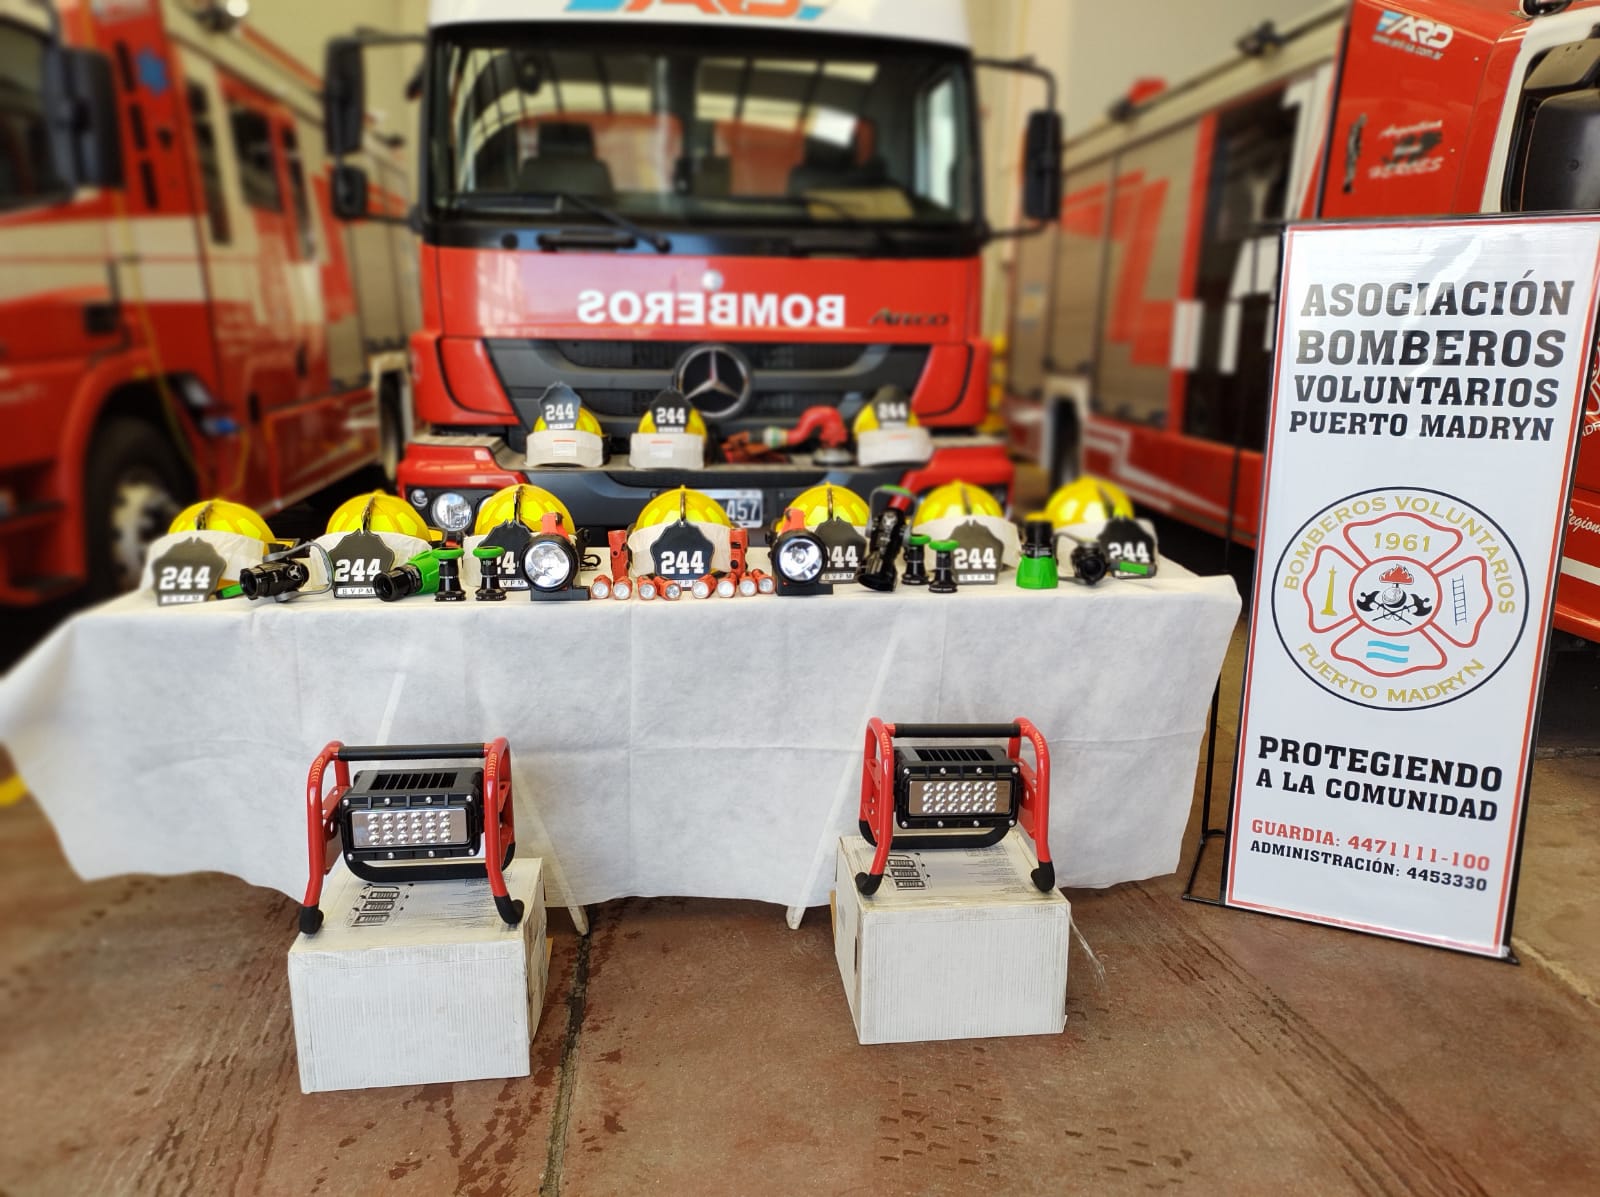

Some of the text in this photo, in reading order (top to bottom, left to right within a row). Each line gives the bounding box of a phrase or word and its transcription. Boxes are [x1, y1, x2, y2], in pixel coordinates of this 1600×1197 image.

[1300, 269, 1575, 317] ASOCIACIÓN
[1295, 329, 1566, 368] BOMBEROS
[1294, 374, 1559, 408] VOLUNTARIOS
[545, 403, 574, 420] 244
[656, 407, 686, 424] 244
[1289, 410, 1555, 441] PUERTO MADRYN
[826, 545, 859, 568] 44
[953, 547, 996, 569] 244
[1108, 542, 1150, 562] 244
[1283, 495, 1516, 615] BOMBEROS VOLUNTARIOS
[1374, 532, 1431, 553] 1961
[159, 566, 210, 590] 244
[334, 558, 381, 582] 244
[661, 550, 704, 575] 244
[1298, 642, 1486, 703] PUERTO MADRYN
[1258, 735, 1503, 792] PROTEGIENDO
[1255, 768, 1498, 822] A LA COMUNIDAD
[1251, 818, 1490, 871] GUARDIA: 4471111-100
[1250, 839, 1488, 892] ADMINISTRACIÓN: 4453330
